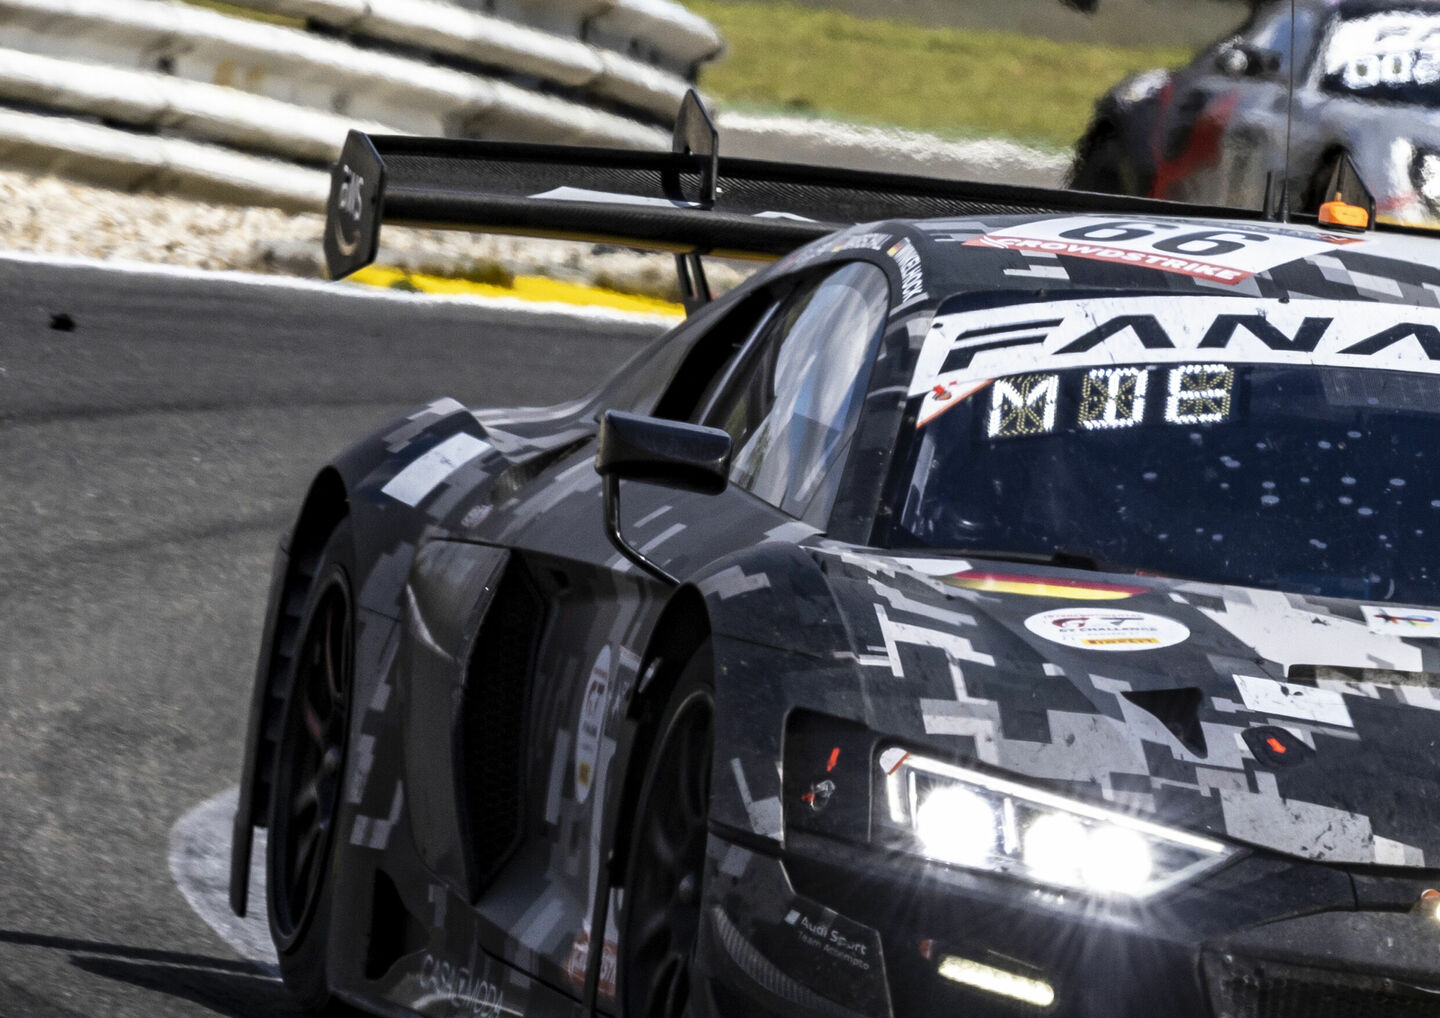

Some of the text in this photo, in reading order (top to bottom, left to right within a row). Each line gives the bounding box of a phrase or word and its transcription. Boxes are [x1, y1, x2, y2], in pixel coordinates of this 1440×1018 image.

[1058, 221, 1270, 256] 66
[1003, 238, 1241, 280] CROWDSTRIKE
[801, 916, 828, 938] Audi
